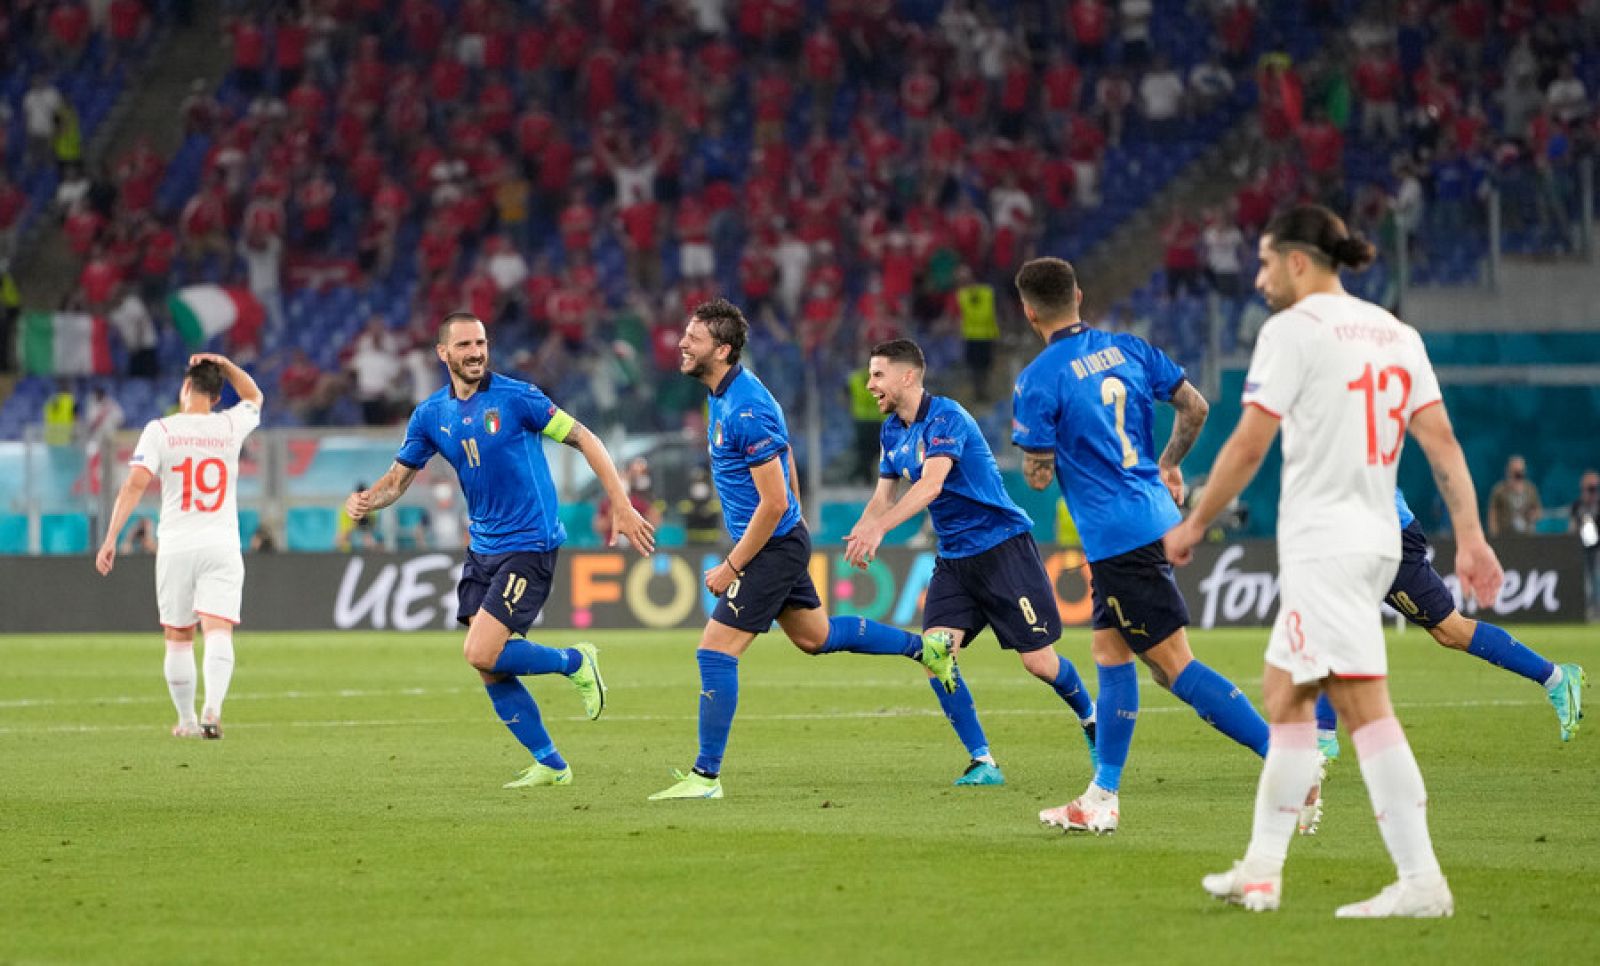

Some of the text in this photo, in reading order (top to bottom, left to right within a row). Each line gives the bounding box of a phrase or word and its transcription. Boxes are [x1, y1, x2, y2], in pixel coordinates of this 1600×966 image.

[1101, 376, 1138, 469] 2
[1346, 362, 1413, 466] 13
[461, 438, 480, 468] 19
[171, 456, 227, 512] 19
[502, 572, 527, 604] 19
[1018, 596, 1037, 625] 8
[1106, 596, 1132, 627] 2
